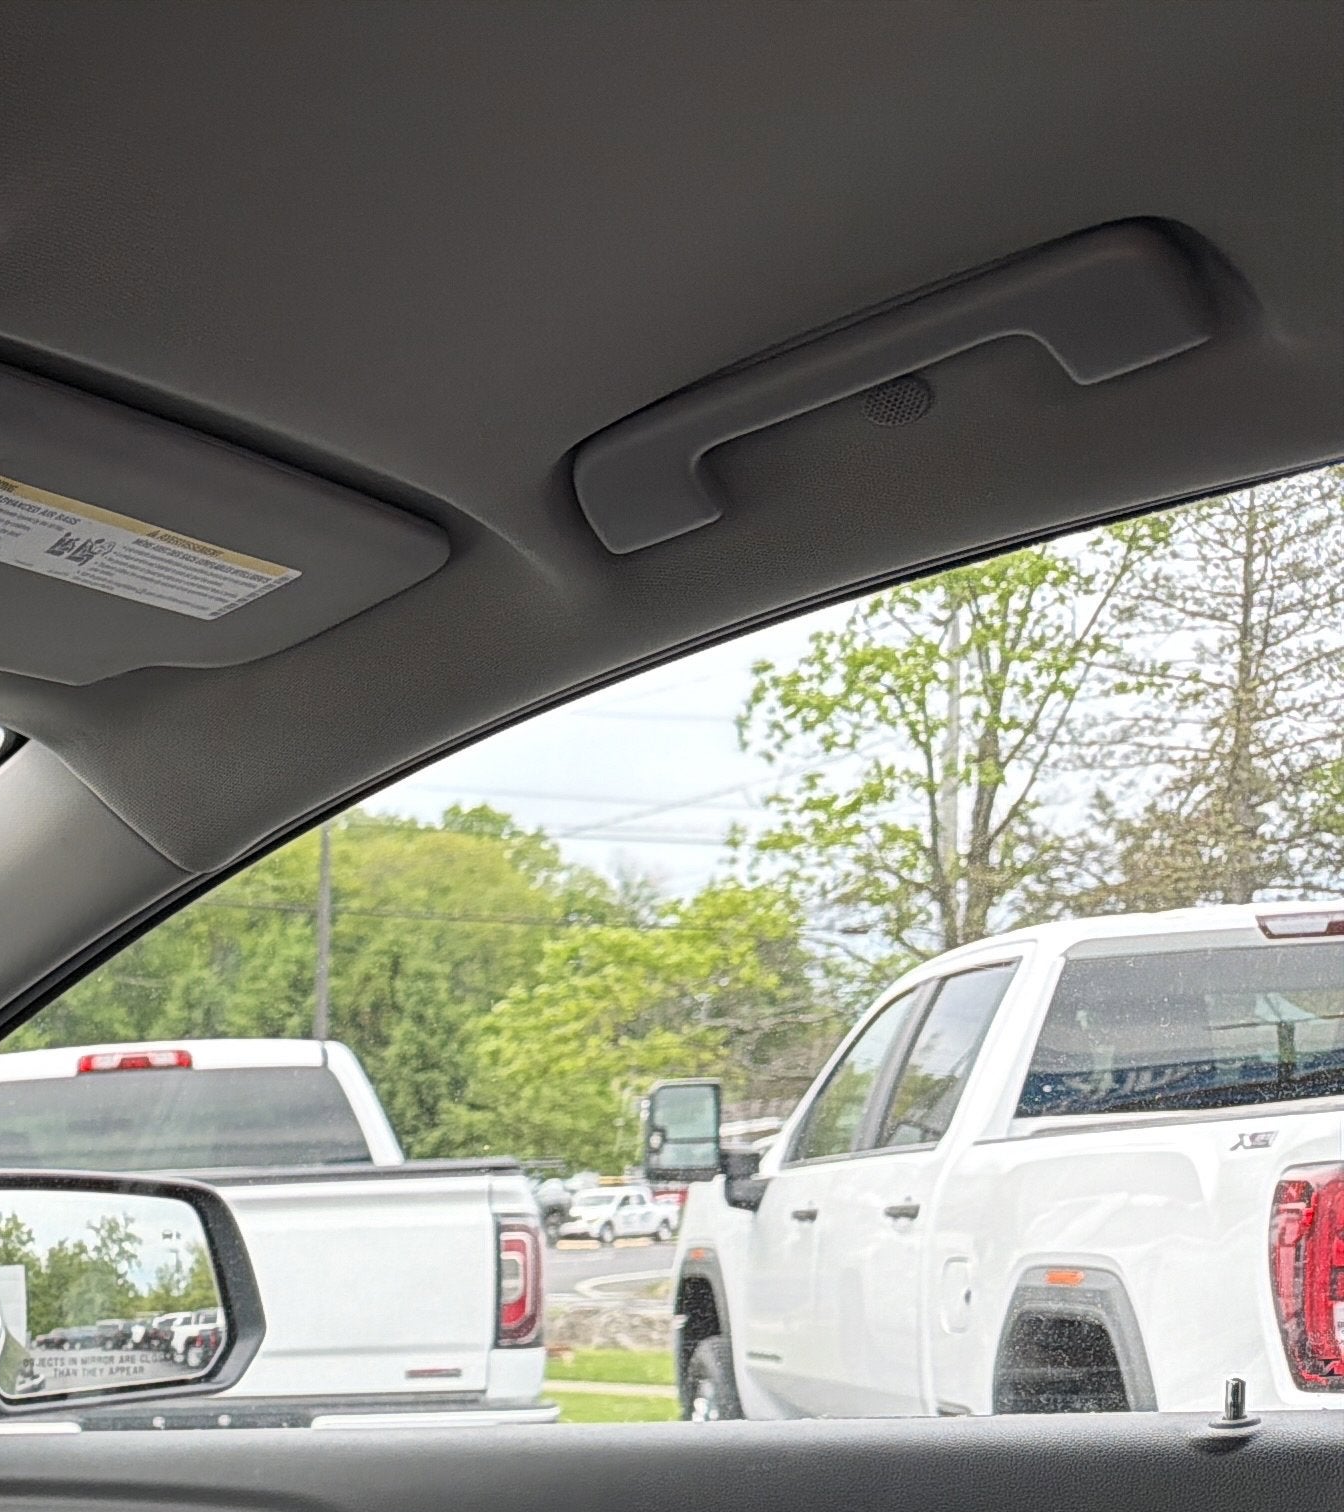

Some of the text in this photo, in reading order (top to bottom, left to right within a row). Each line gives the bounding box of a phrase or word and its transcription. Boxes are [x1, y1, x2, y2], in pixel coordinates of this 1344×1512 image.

[67, 1357, 78, 1367] IN
[80, 1355, 118, 1367] MIRROR
[118, 1354, 137, 1366] ARE
[53, 1365, 145, 1378] THAN THEY APPEAR
